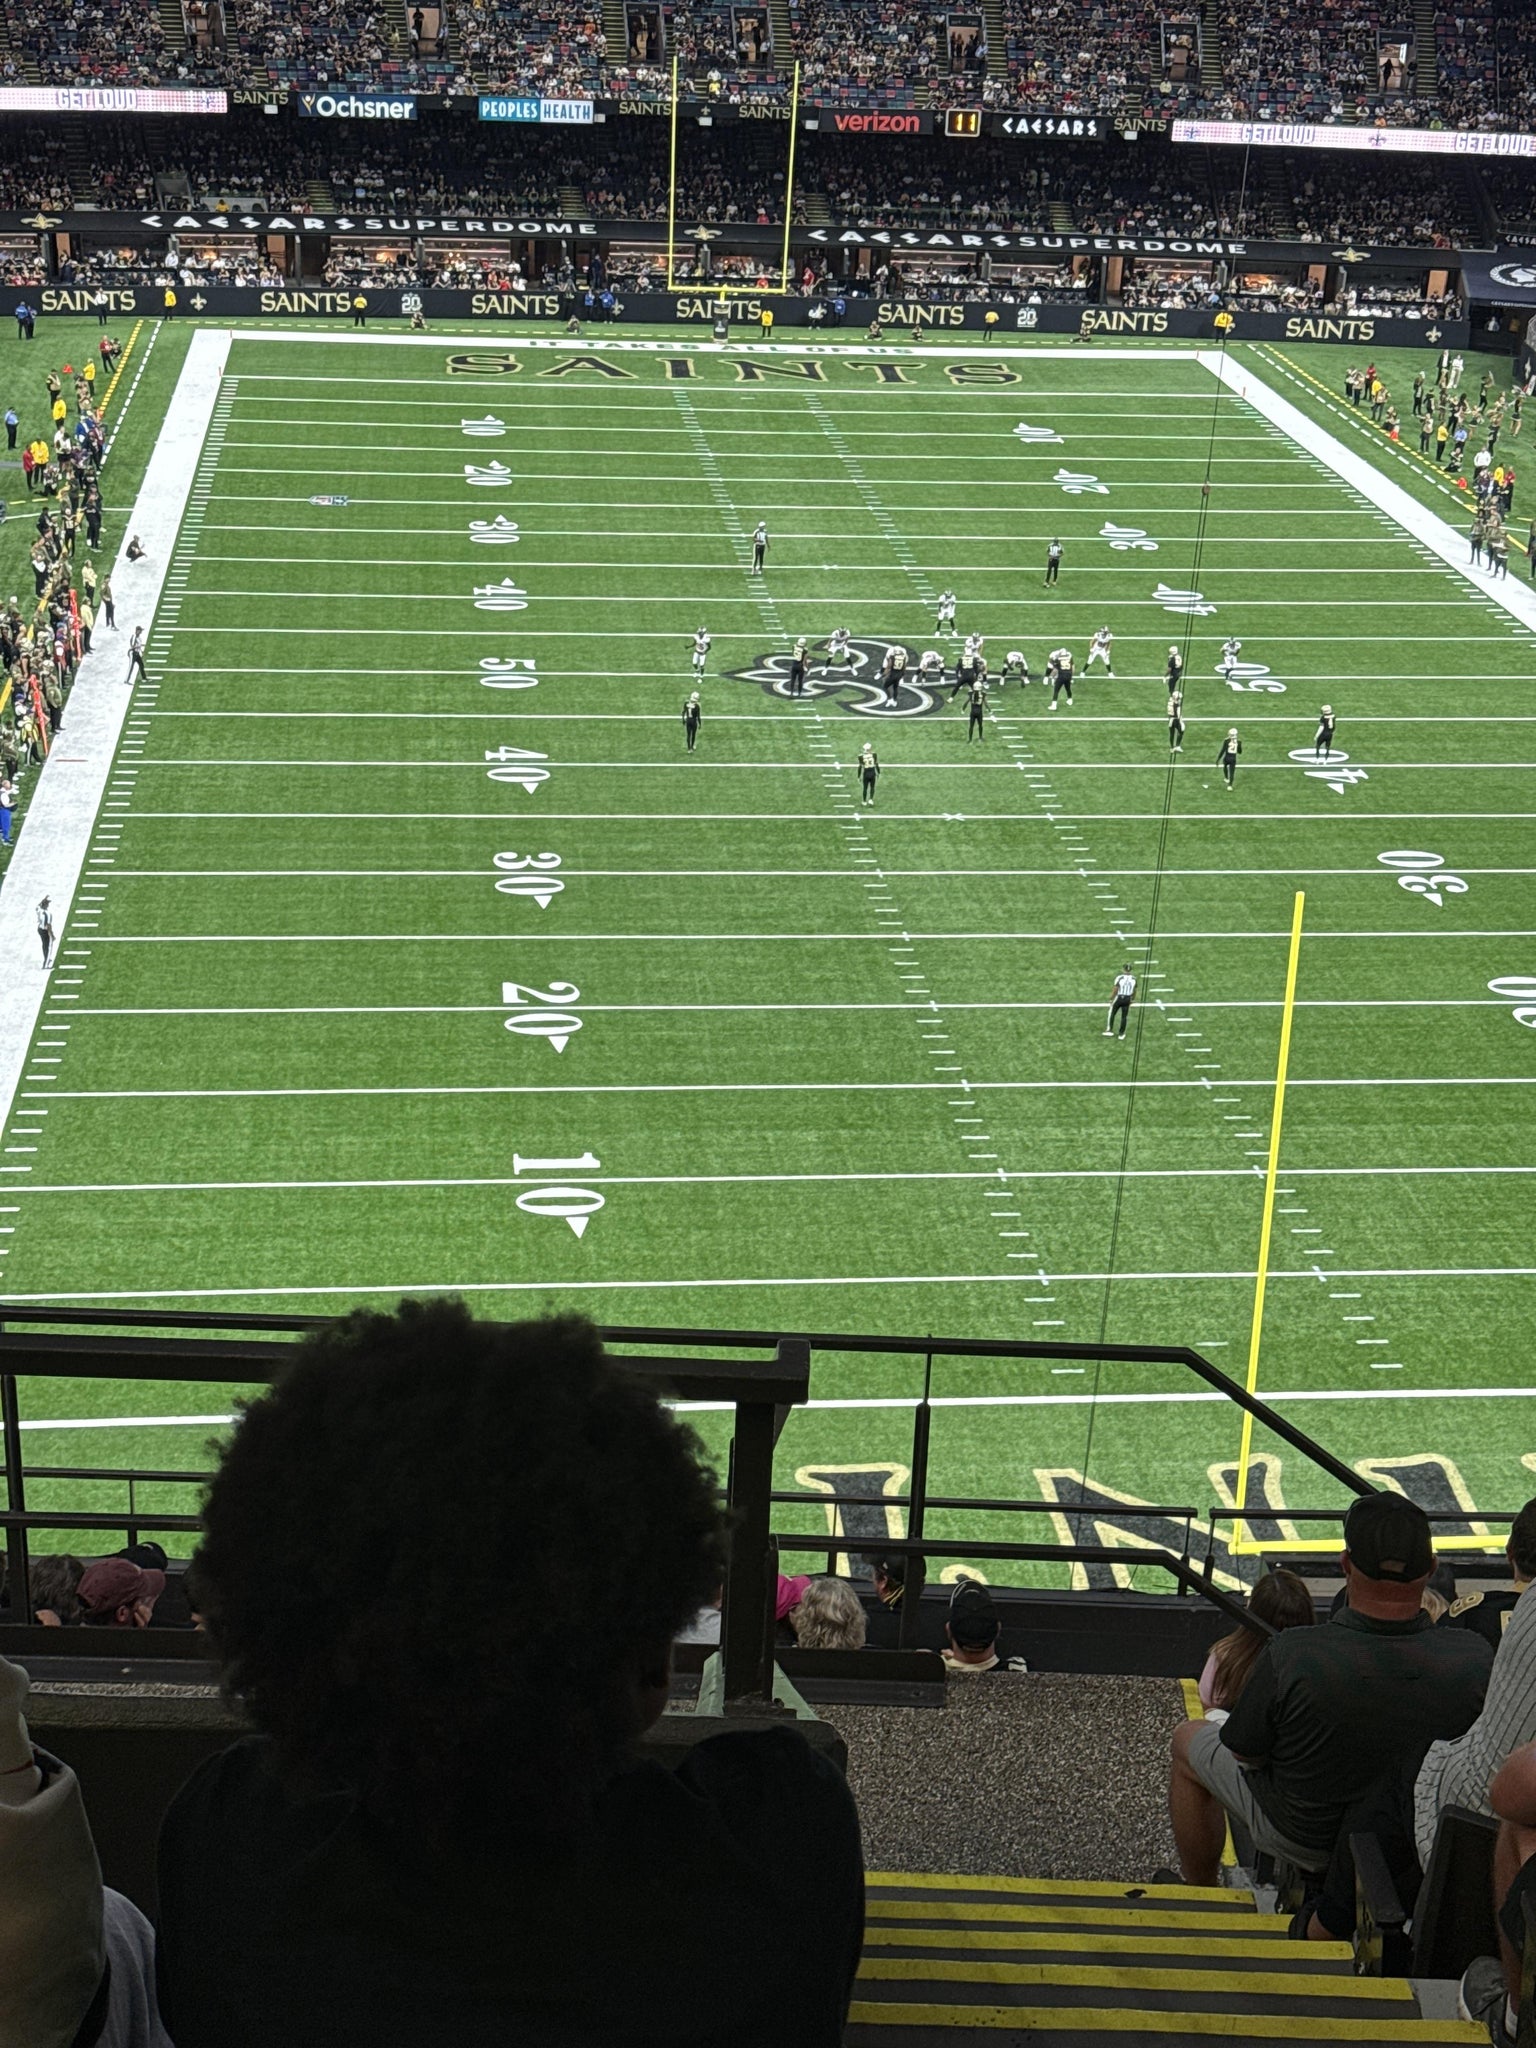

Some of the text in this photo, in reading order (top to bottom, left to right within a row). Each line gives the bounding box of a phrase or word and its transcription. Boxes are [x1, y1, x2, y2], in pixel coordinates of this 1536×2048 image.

[57, 88, 138, 110] GET LOUD
[233, 90, 289, 105] SAINTS
[316, 95, 414, 119] Ochsner
[482, 100, 592, 120] PEOPLES HEALTH
[618, 102, 672, 116] SAINTS
[738, 105, 791, 120] SAINTS
[834, 110, 920, 132] verizon
[956, 113, 977, 132] 11
[1001, 115, 1098, 137] CAESARS
[1114, 117, 1167, 132] SAINTS
[1241, 123, 1315, 144] GET LOUD
[1454, 132, 1532, 154] GET LOUD
[141, 215, 598, 235] CAESARS SUPERDOME
[808, 229, 1247, 255] CAESARS SUPERDOME
[260, 291, 352, 313] SAINTS
[401, 295, 423, 312] 20
[471, 293, 560, 316] SAINTS
[676, 298, 762, 321] SAITS
[878, 303, 965, 325] SAINTS
[1017, 309, 1038, 326] 20
[1081, 308, 1168, 332] SAINTS
[1285, 317, 1375, 341] SAINTS
[580, 341, 701, 350] TAKES
[446, 353, 1023, 384] SAINTS
[463, 464, 513, 487] 20
[468, 519, 520, 544] 30
[473, 584, 529, 611] 40
[479, 656, 539, 689] 50
[485, 745, 551, 783] 40
[492, 851, 565, 895] 30
[1376, 850, 1469, 893] 30
[502, 981, 584, 1036] 20
[512, 1151, 606, 1217] 10
